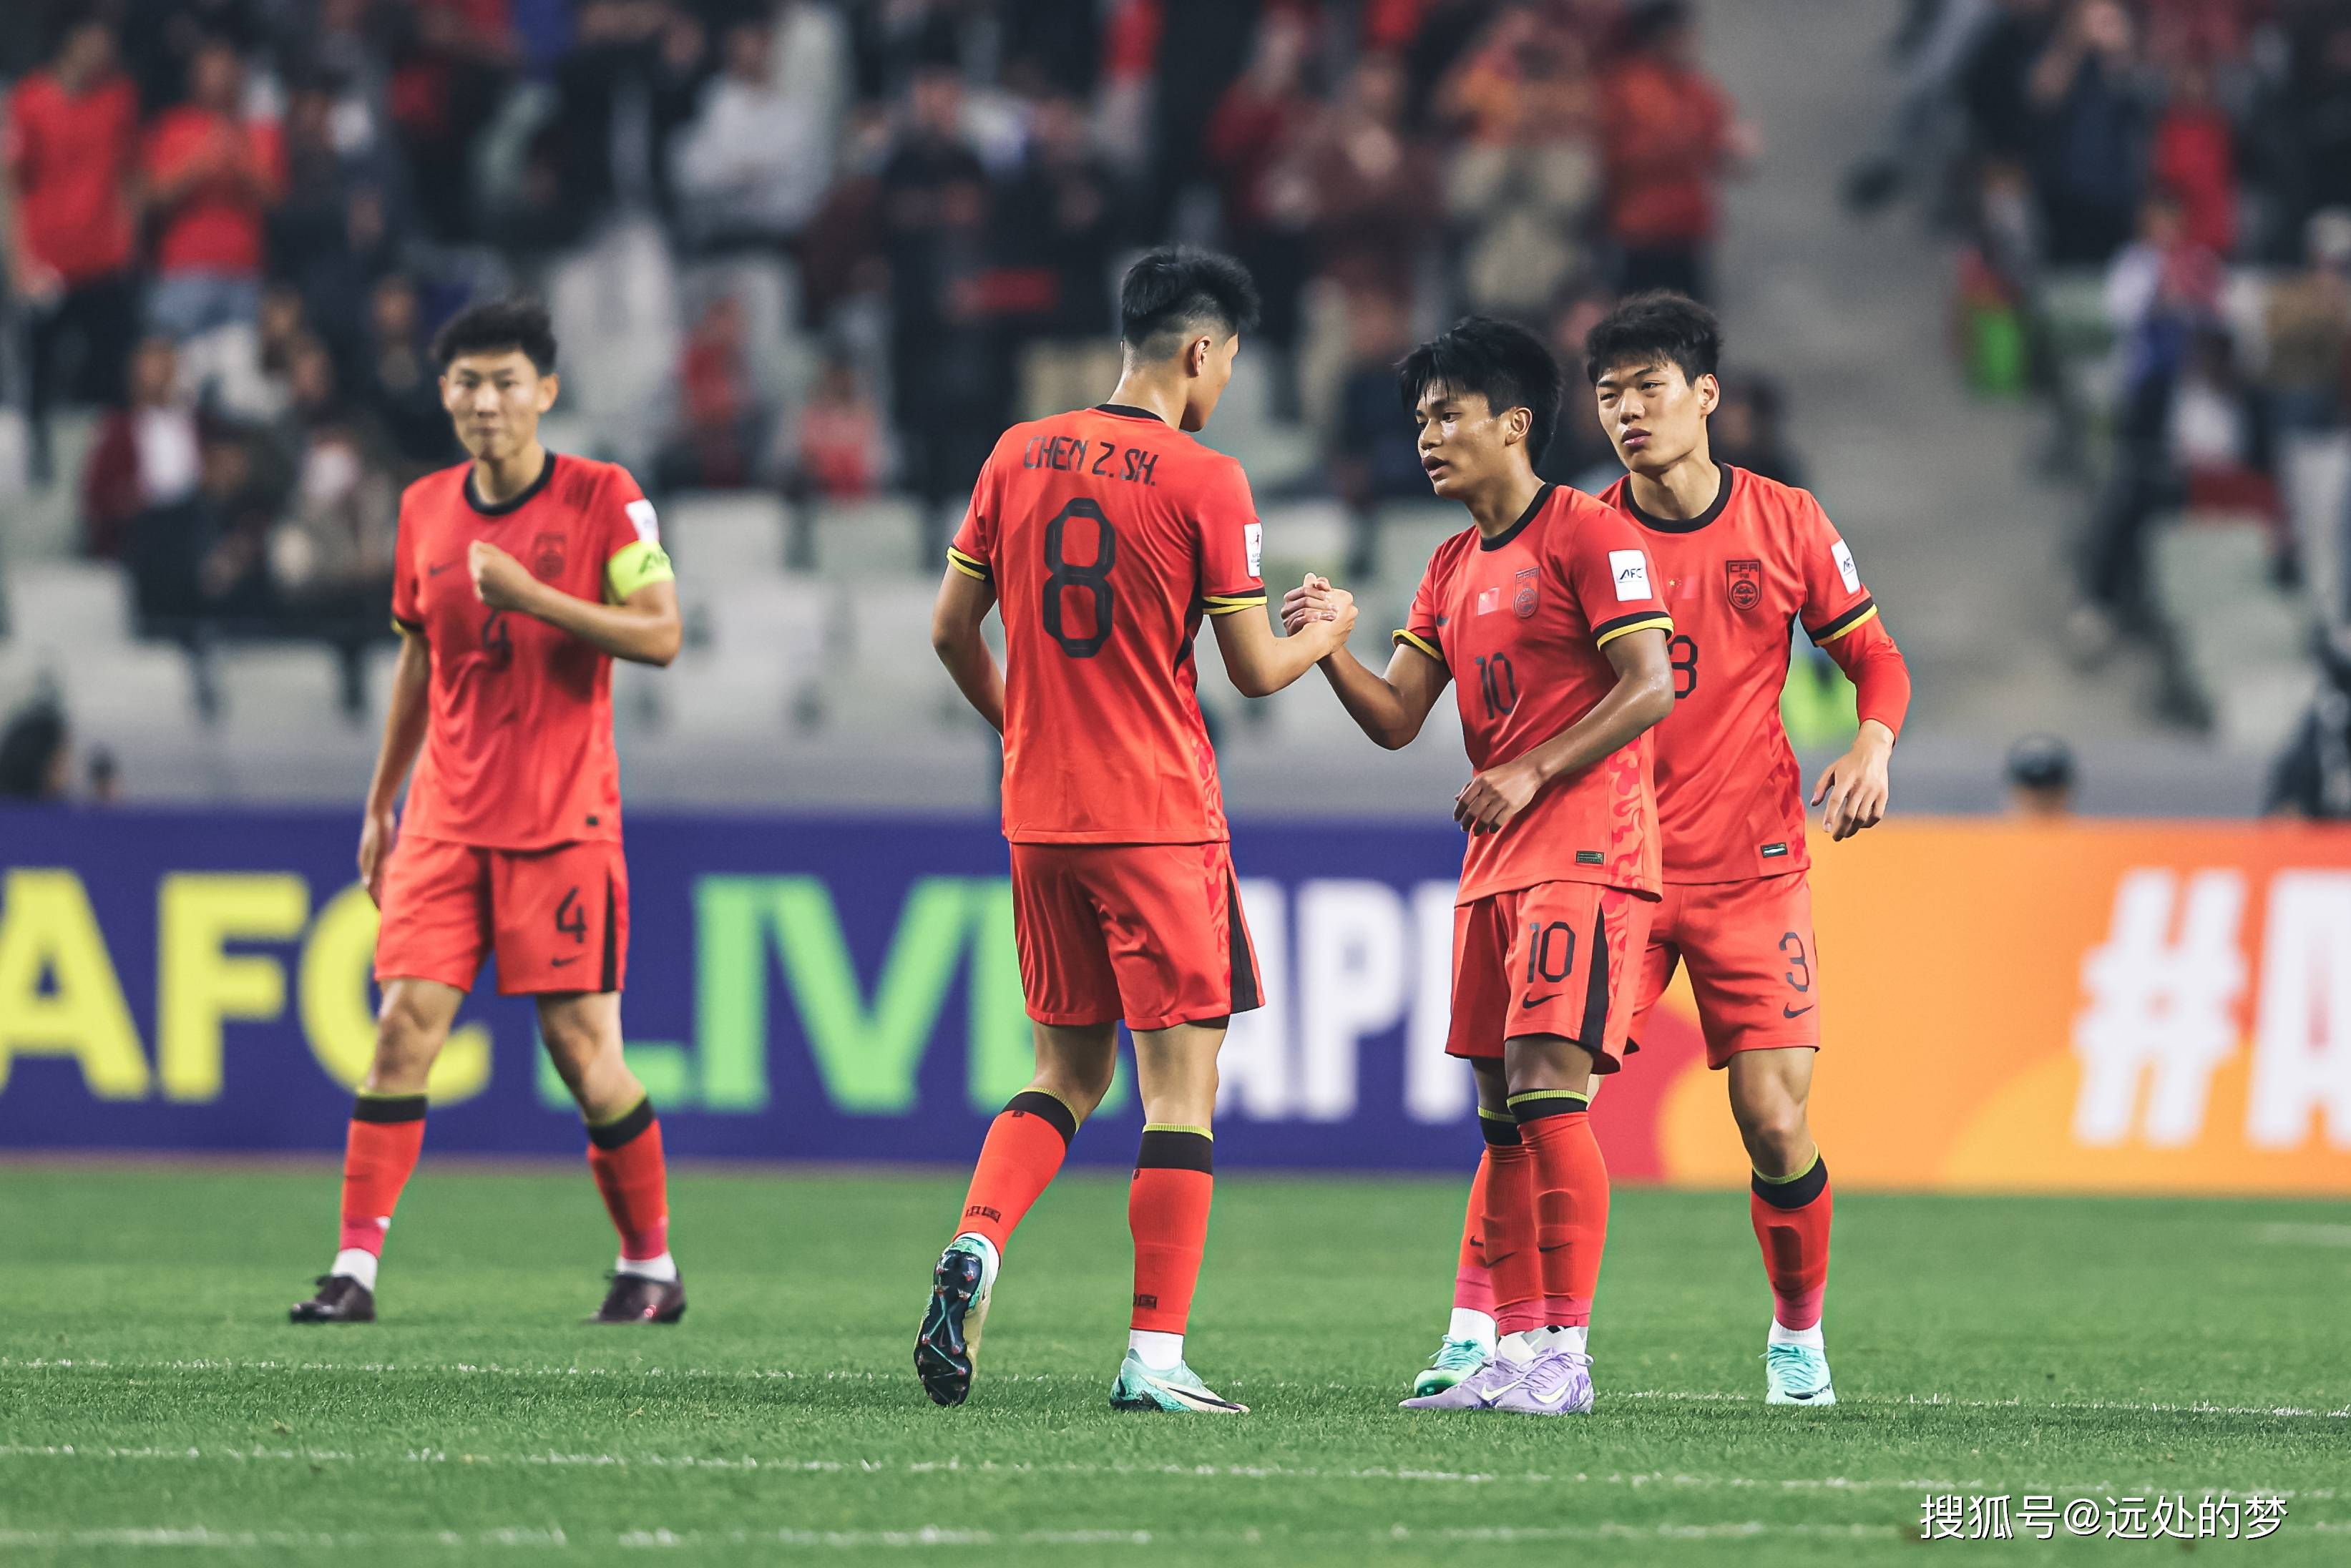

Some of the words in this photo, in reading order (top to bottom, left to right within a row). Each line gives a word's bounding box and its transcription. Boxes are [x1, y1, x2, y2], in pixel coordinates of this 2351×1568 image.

[1023, 435, 1089, 472] CHEN
[1042, 497, 1116, 658] 8
[1619, 568, 1643, 580] AFC
[1476, 652, 1517, 720] 10
[1667, 634, 1698, 699] 3
[555, 886, 587, 944] 4
[1527, 921, 1576, 983] 10
[1779, 932, 1809, 993] 3
[0, 867, 494, 1107] AFC
